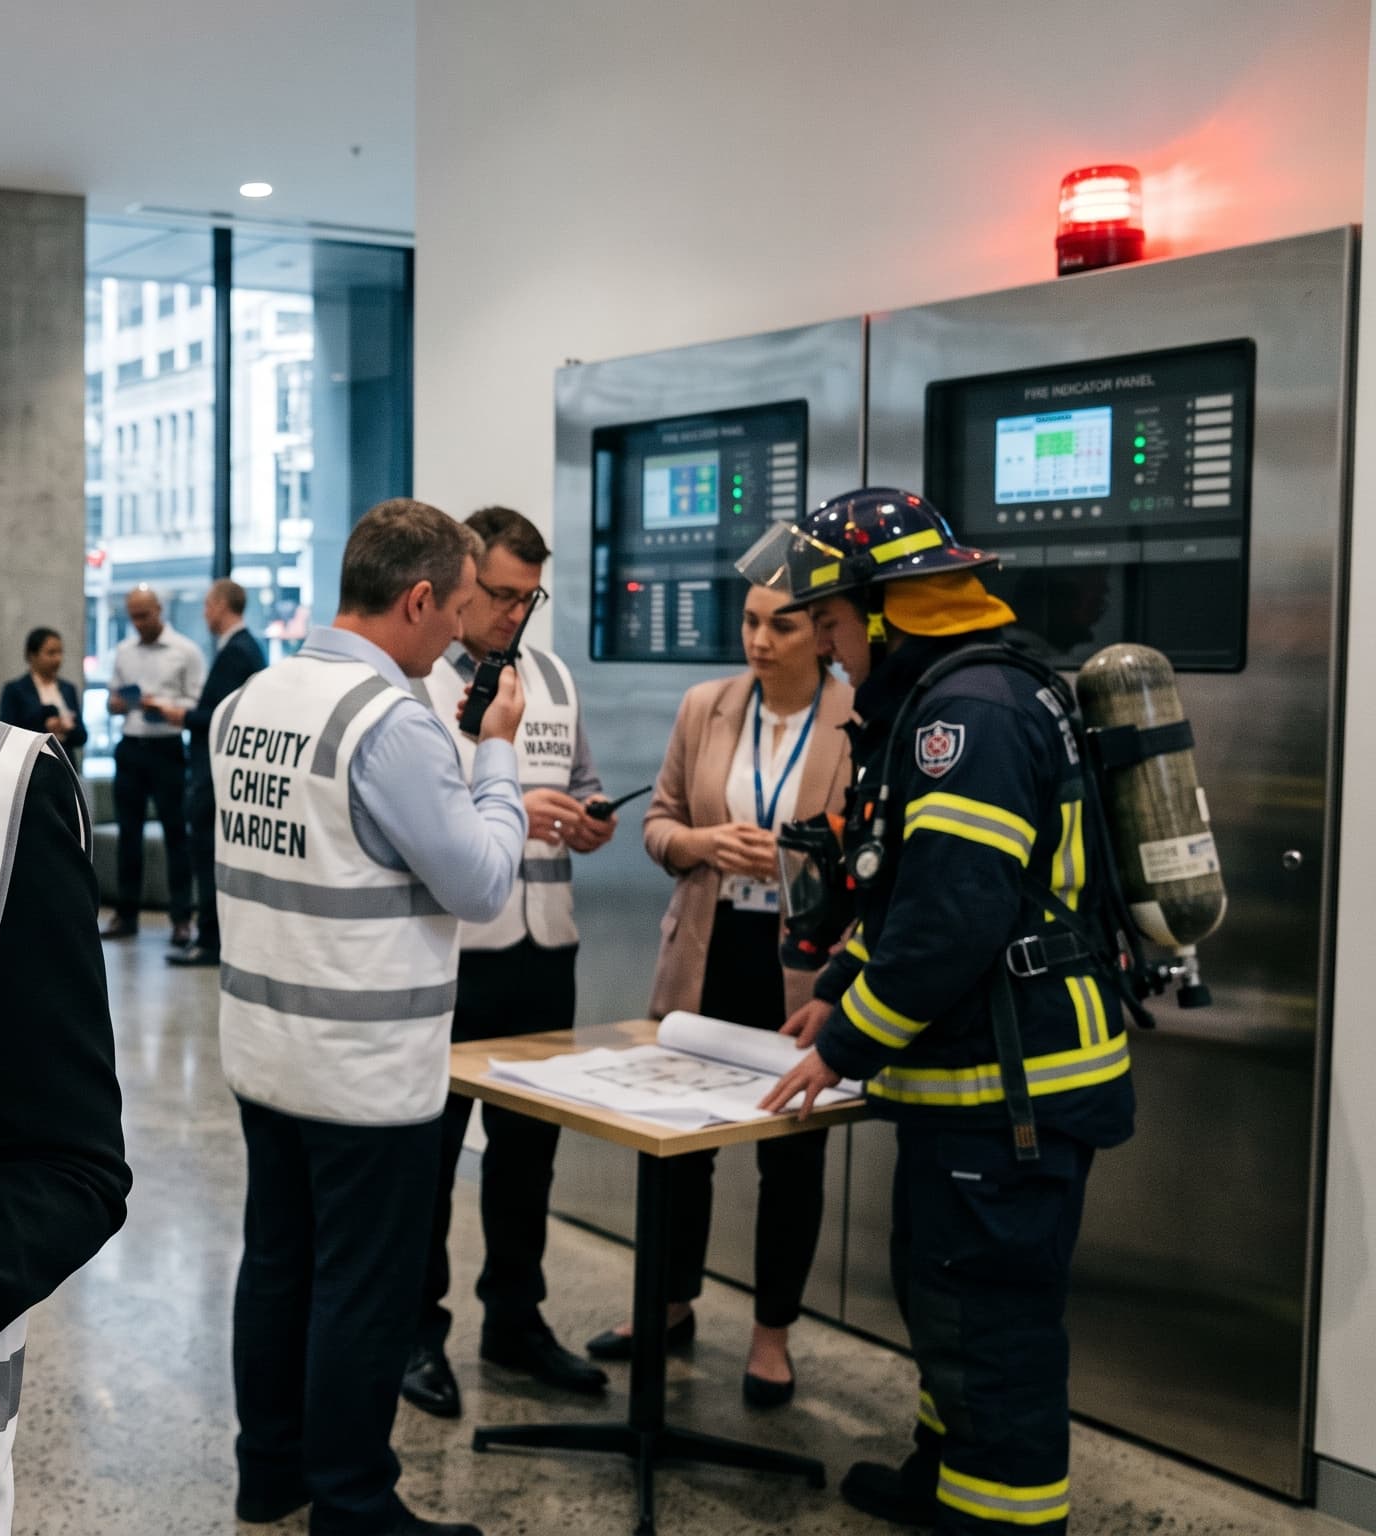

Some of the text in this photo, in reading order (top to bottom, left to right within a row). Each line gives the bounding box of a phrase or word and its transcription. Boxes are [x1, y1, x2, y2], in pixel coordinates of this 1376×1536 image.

[1052, 379, 1112, 398] INDICATOR
[525, 722, 569, 739] DEPUTY
[225, 725, 311, 768] DEPUTY
[230, 768, 291, 809] CHIEF
